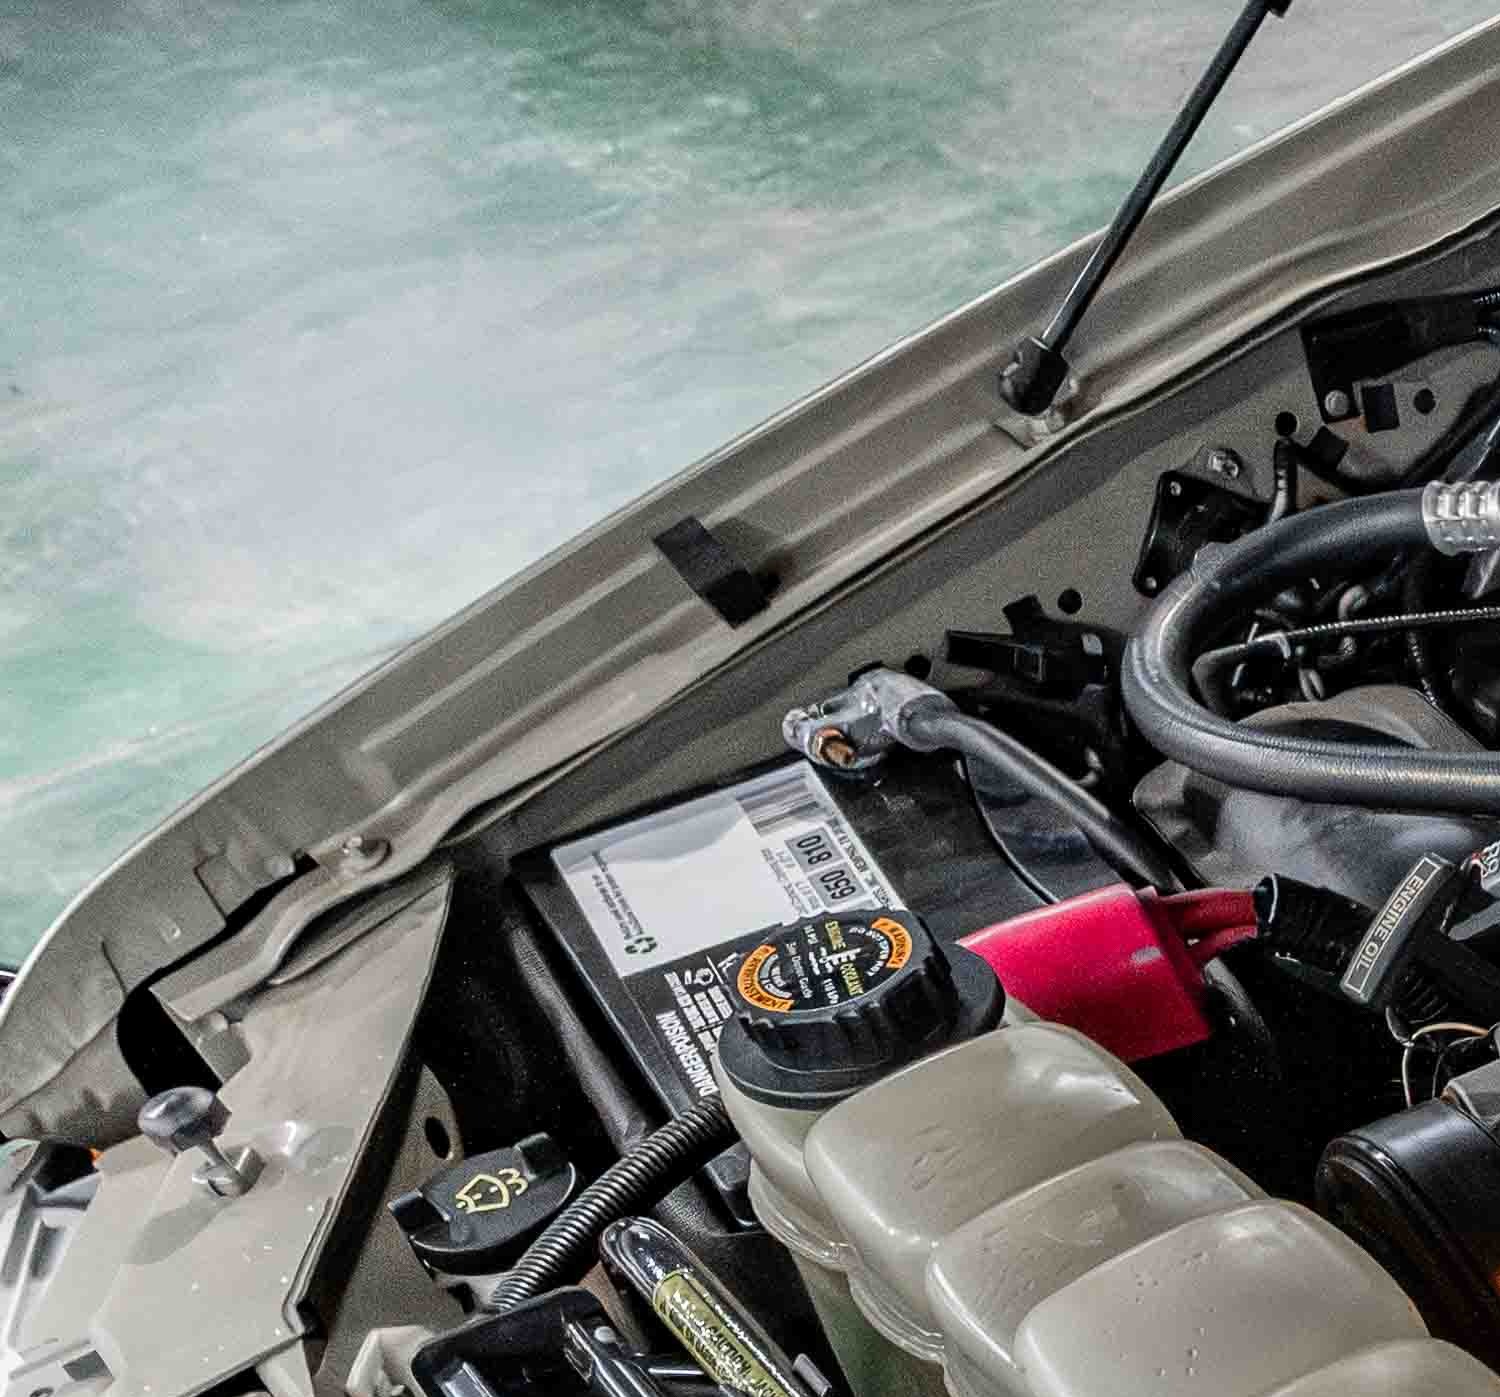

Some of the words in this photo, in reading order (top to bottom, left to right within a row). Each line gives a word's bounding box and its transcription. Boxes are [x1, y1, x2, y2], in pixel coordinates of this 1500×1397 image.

[795, 832, 833, 867] 810
[818, 866, 857, 902] 650
[1373, 874, 1424, 941] ENGINE
[1356, 940, 1380, 972] OIL
